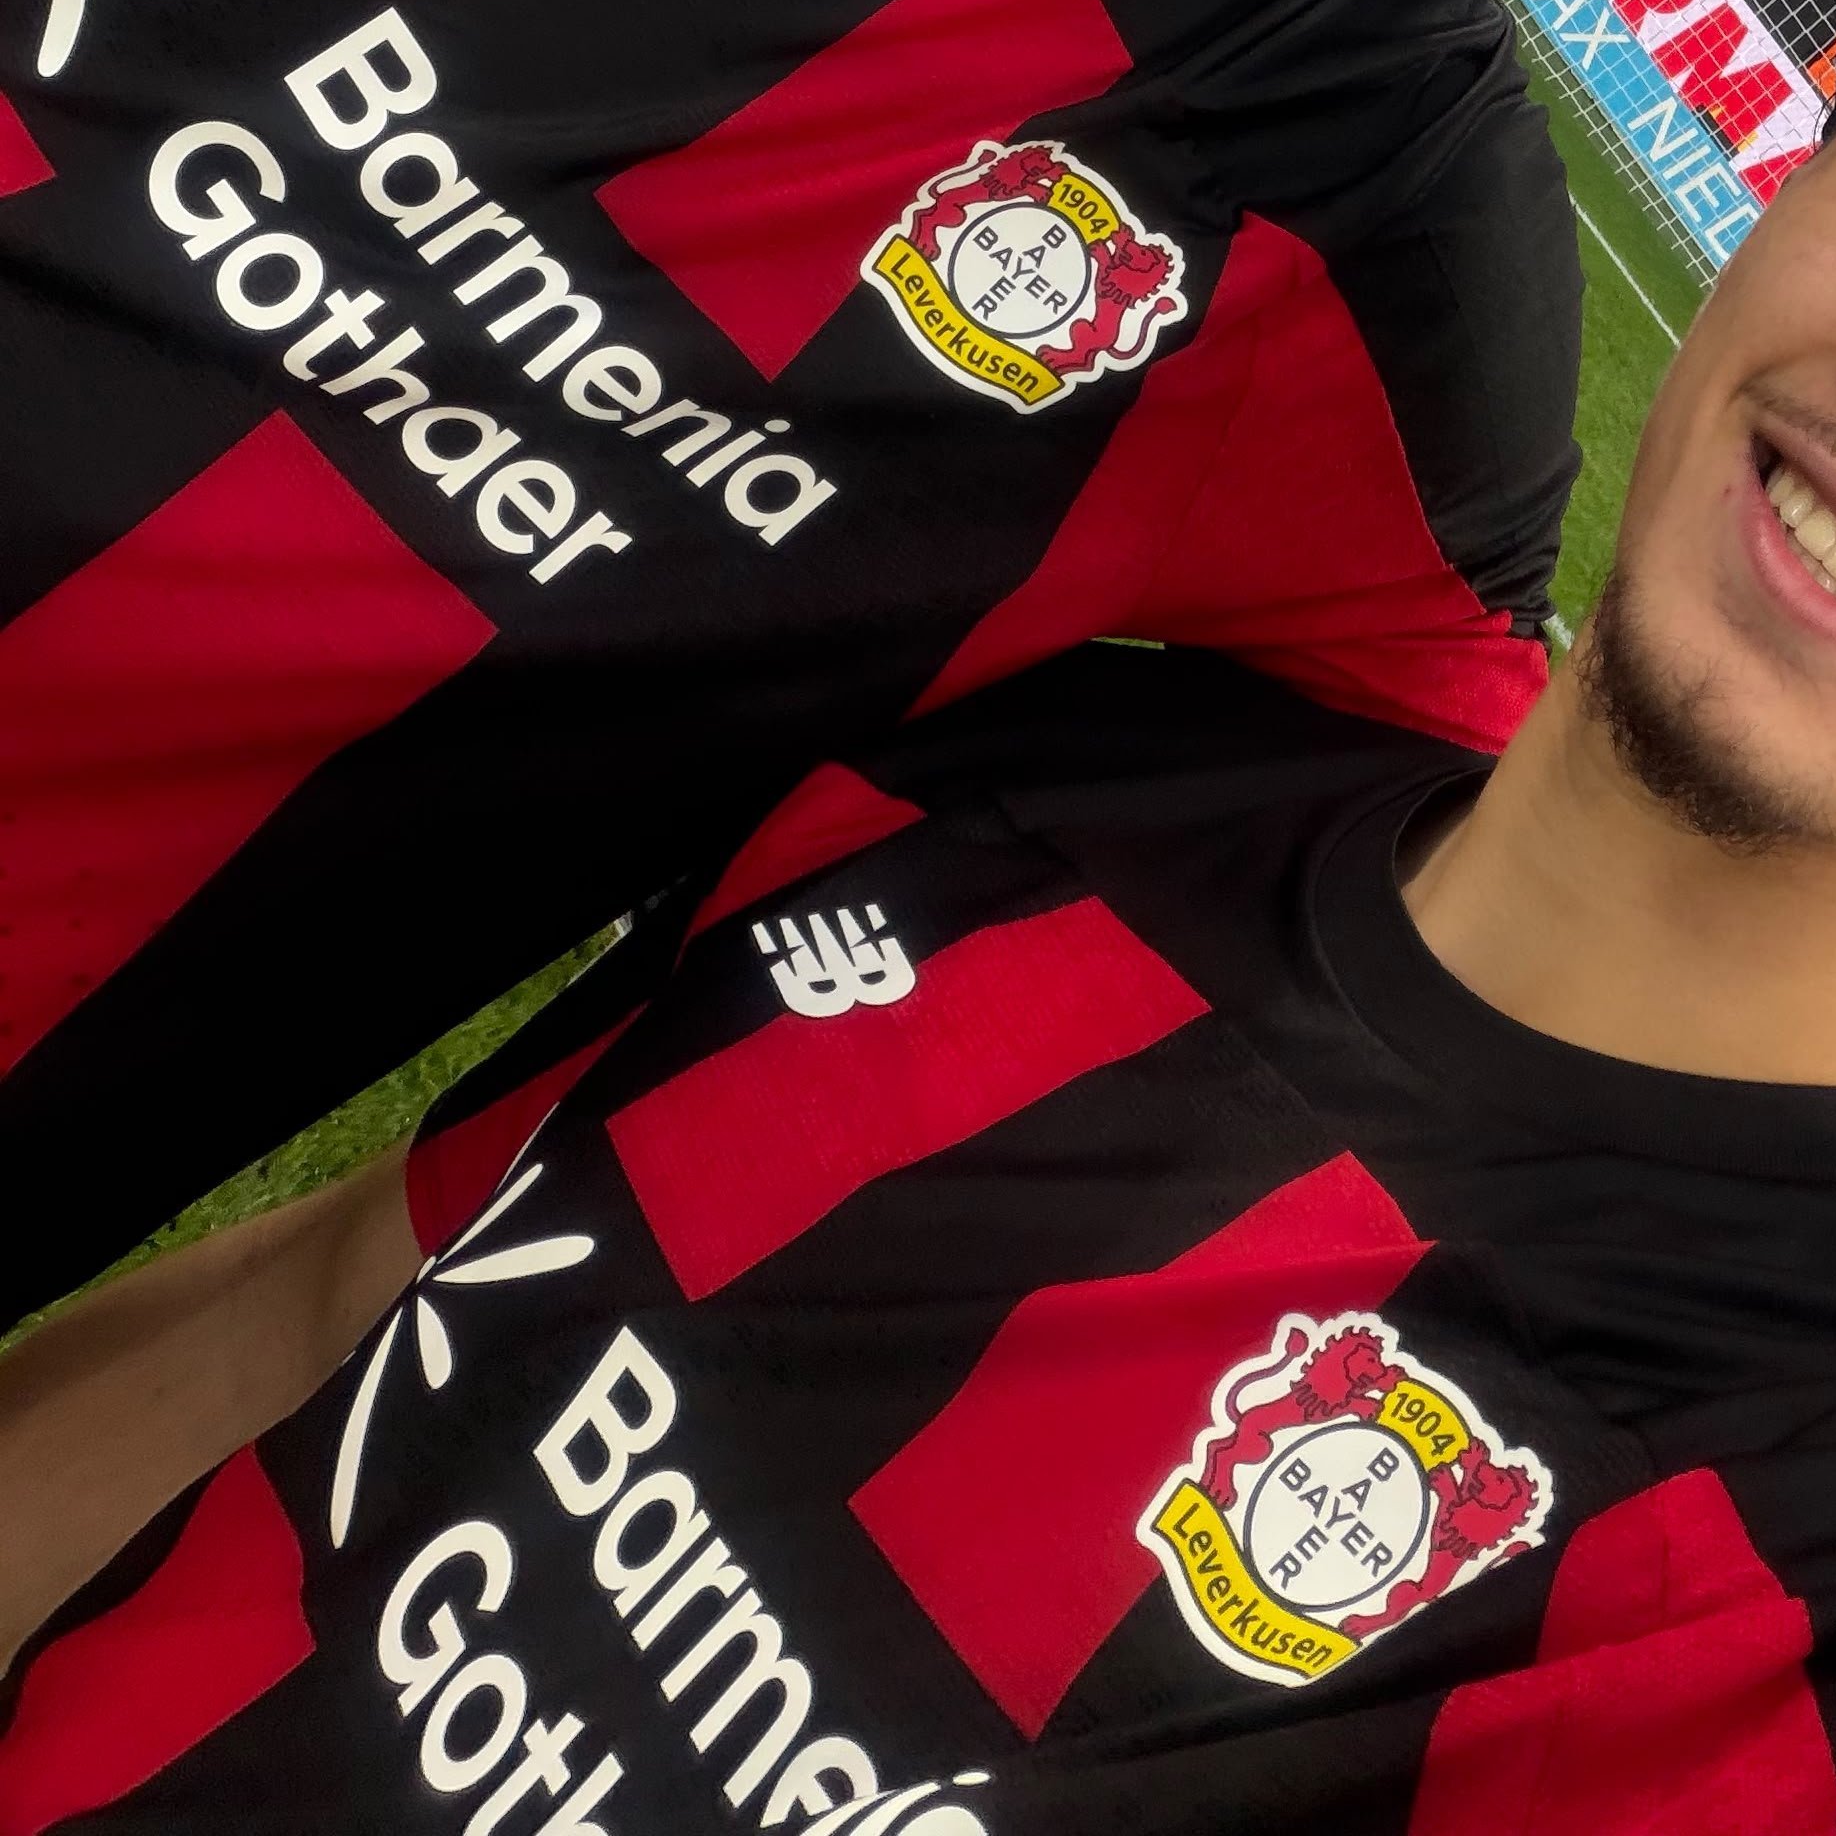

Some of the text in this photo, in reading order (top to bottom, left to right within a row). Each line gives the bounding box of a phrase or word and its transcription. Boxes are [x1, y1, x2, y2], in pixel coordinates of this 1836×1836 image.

[971, 226, 1070, 316] BAYER
[972, 222, 1068, 322] BAYER
[1056, 181, 1112, 238] 1904
[284, 6, 838, 547] Barmenia
[888, 252, 1043, 399] Leverkusen
[148, 120, 633, 585] Gothaer
[1391, 1390, 1458, 1460] 1904
[1269, 1446, 1400, 1591] BAYER
[1279, 1458, 1394, 1577] BAYER
[1170, 1503, 1334, 1671] Leverkusen
